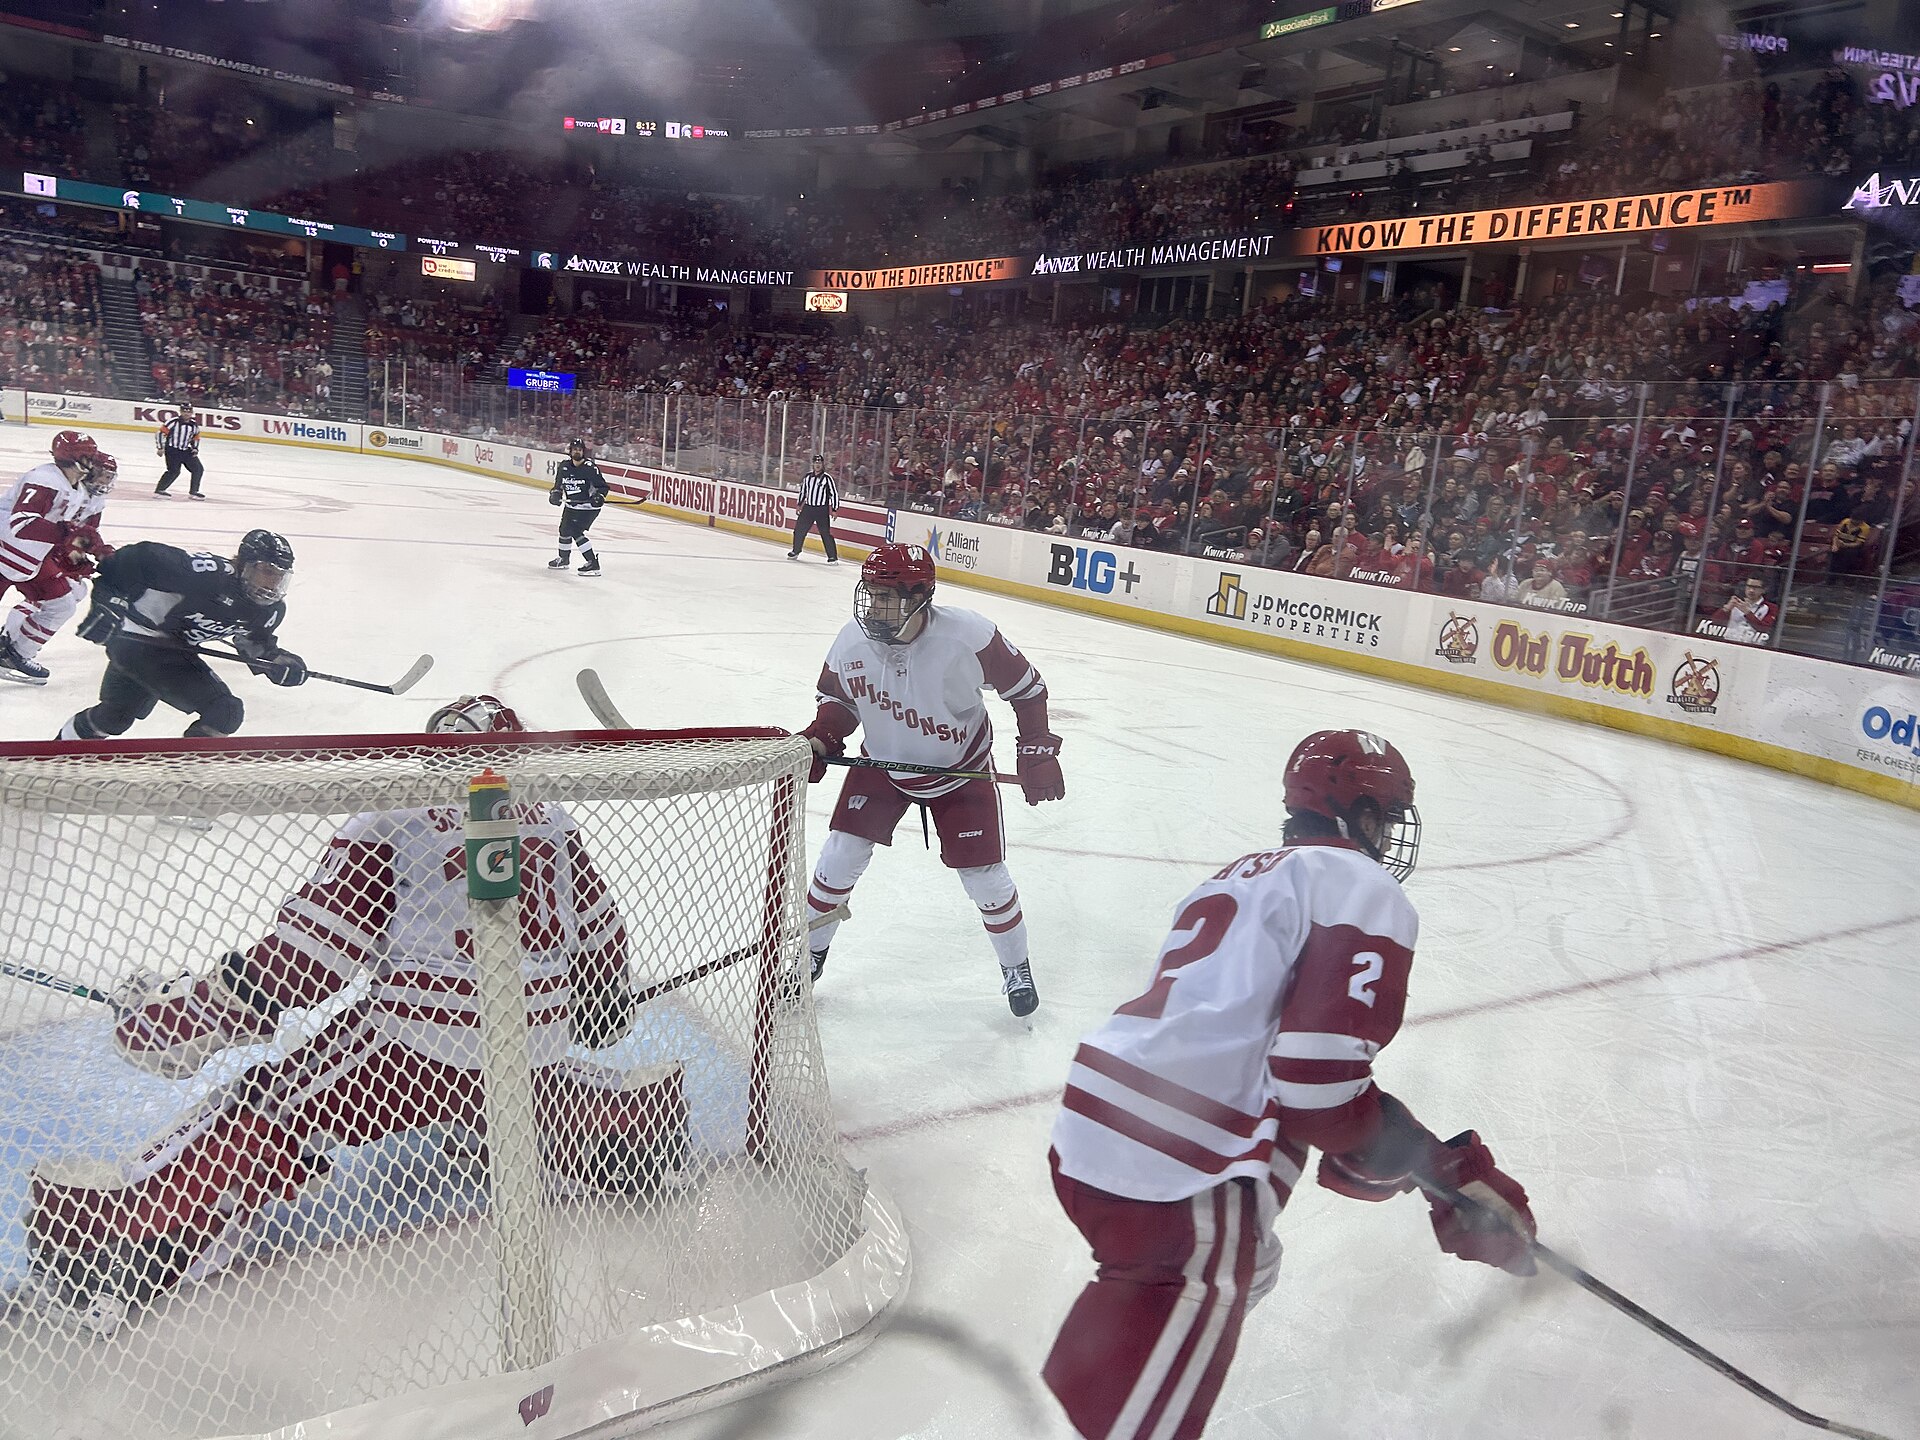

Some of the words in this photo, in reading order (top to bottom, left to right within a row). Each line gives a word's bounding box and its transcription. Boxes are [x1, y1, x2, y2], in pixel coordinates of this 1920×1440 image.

[103, 34, 129, 47] BIG
[132, 40, 162, 54] TEN
[165, 46, 271, 77] TOURNAMENT
[273, 70, 354, 95] CHAMPIONS
[785, 127, 811, 137] FOUR
[1119, 59, 1146, 75] 2010
[575, 120, 599, 128] TOYOTA
[636, 121, 657, 131] 8:12
[705, 129, 729, 137] TOYOTA
[37, 179, 45, 192] 1
[226, 207, 249, 216] SHOTS
[231, 214, 246, 226] 14
[288, 217, 317, 228] FACEOFF
[317, 222, 335, 231] WINS
[304, 226, 318, 237] 13
[371, 231, 396, 239] BLOCKS
[1316, 222, 1407, 252] KNOW
[1418, 216, 1476, 244] THE
[379, 239, 388, 248] 0
[417, 237, 440, 245] POWER
[440, 240, 459, 248] PLAYS
[431, 245, 447, 255] 1/1
[489, 252, 507, 263] 1/2
[1031, 253, 1084, 275] ANNEX
[1086, 247, 1146, 270] WEALTH
[1150, 235, 1274, 265] MANAGEMENT
[563, 254, 624, 275] ANNEX
[627, 261, 690, 280] WEALTH
[696, 267, 795, 286] MANAGEMENT
[823, 271, 878, 289] KNOW
[881, 269, 904, 287] THE
[813, 296, 841, 308] COUSINS
[474, 443, 494, 464] Quartz
[22, 488, 37, 504] 7
[651, 473, 715, 513] WISCONSIN
[718, 484, 786, 528] BADGERS
[946, 531, 980, 552] Alliant
[263, 610, 279, 628] A
[1252, 594, 1274, 611] JD
[1276, 598, 1383, 632] McCORMICK
[1251, 612, 1379, 648] PROPERTIES
[1491, 620, 1550, 677] Old
[1556, 631, 1656, 697] Dutch
[846, 675, 968, 746] WISCONSIN
[1856, 749, 1882, 764] FETA
[848, 758, 925, 773] JETSPEED
[958, 829, 983, 838] CCM
[476, 839, 515, 883] G
[1112, 892, 1239, 1020] 2
[1348, 950, 1385, 1009] 2
